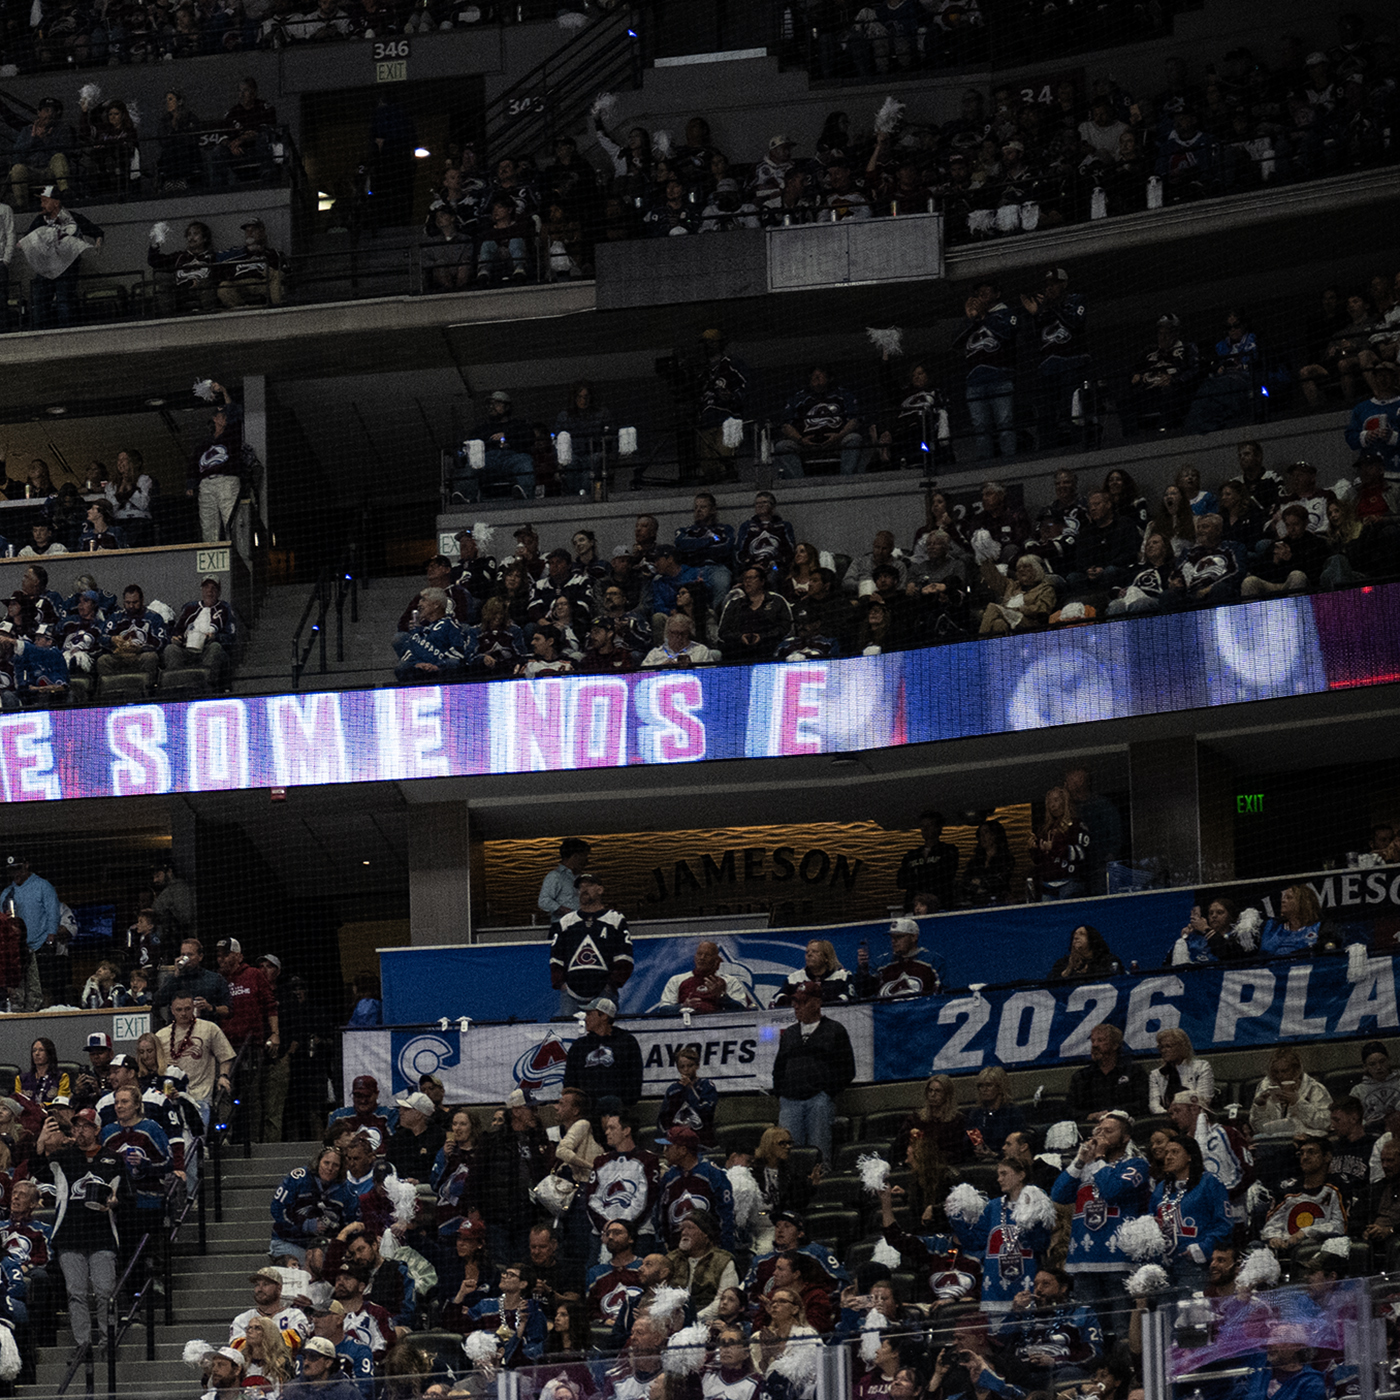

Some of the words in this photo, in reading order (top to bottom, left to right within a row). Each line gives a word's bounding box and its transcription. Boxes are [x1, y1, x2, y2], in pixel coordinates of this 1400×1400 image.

[375, 41, 409, 57] 346
[379, 63, 405, 79] EXIT
[199, 553, 227, 569] EXIT
[107, 685, 449, 799] SOME
[1237, 794, 1263, 813] EXIT
[648, 846, 863, 904] JAMESON
[931, 975, 1185, 1071] 2026
[1212, 955, 1400, 1042] PLA
[117, 1017, 146, 1038] EXIT
[645, 1039, 757, 1069] AYOFFS
[273, 1187, 288, 1202] 91
[723, 1190, 730, 1202] 8
[828, 1255, 838, 1268] 9
[13, 1268, 21, 1281] 2
